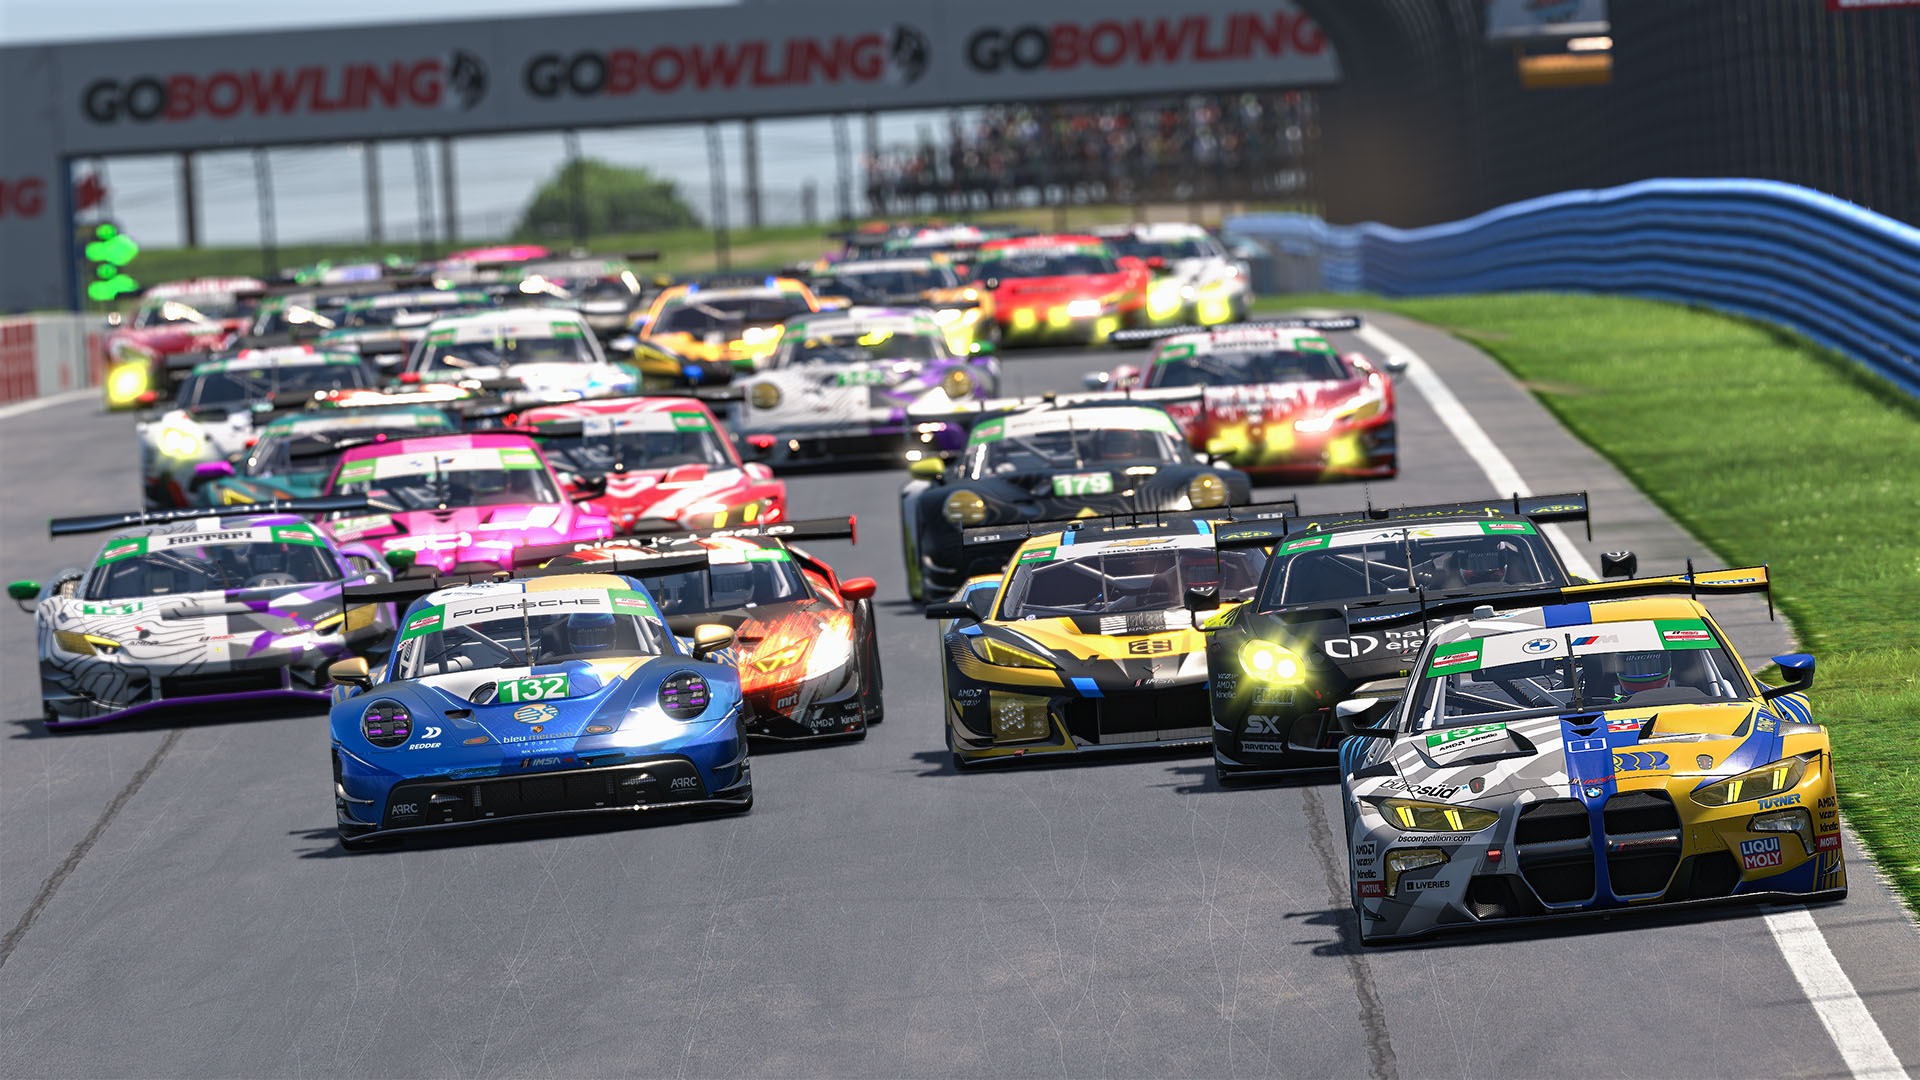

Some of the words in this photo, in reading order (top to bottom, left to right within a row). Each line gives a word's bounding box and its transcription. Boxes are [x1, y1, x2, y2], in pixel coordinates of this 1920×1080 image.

[523, 34, 887, 100] GOBOWLING
[82, 58, 448, 125] GOBOWLING
[1059, 475, 1110, 495] 179
[166, 530, 252, 546] Ferrari
[1098, 545, 1180, 555] CHEVROLET
[453, 598, 600, 619] PORSCHE
[502, 677, 566, 703] 132
[1216, 681, 1235, 689] AMD
[958, 689, 980, 697] AMD
[777, 693, 799, 709] mrt
[810, 718, 833, 728] AMD
[1244, 715, 1281, 734] SX
[503, 735, 526, 744] bleu
[1439, 741, 1464, 751] AMD
[1470, 732, 1498, 742] kinetic
[409, 742, 441, 751] REDDER
[1244, 743, 1280, 752] RAVENOL
[533, 757, 561, 766] IMSA
[1379, 778, 1462, 799] bürosüd
[1757, 793, 1801, 811] TURNER
[1817, 797, 1835, 808] AMD
[1819, 822, 1839, 832] kinetic
[1397, 834, 1471, 844] bscompetition.com
[1819, 836, 1838, 848] MOTUL
[1355, 843, 1373, 855] AMD
[1742, 837, 1780, 855] LIQUI
[1744, 852, 1782, 869] MOLY
[1357, 870, 1377, 879] kinetic
[1361, 883, 1381, 894] MOTUL
